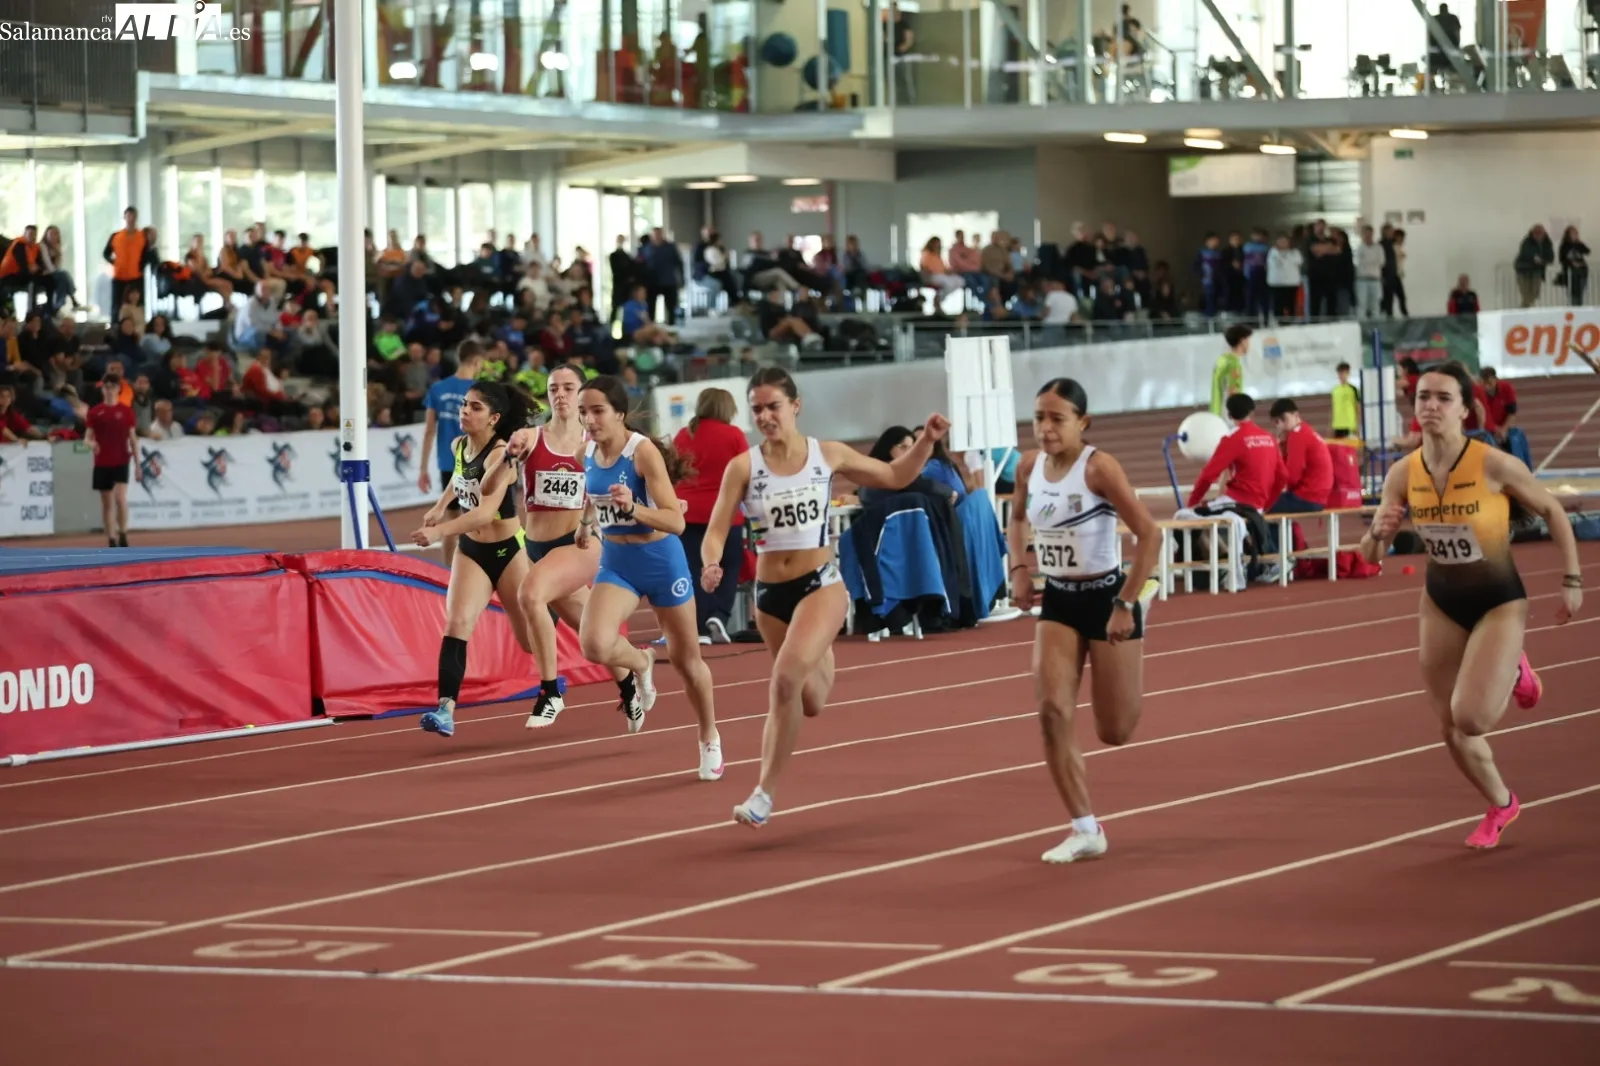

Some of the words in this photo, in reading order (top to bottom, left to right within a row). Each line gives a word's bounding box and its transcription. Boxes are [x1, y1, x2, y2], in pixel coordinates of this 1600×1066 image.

[1505, 311, 1600, 367] enjo
[543, 478, 578, 497] 2443
[770, 499, 819, 528] 2563
[1038, 544, 1078, 568] 2572
[1425, 538, 1472, 559] 2419
[1080, 574, 1117, 592] PRO
[0, 662, 95, 714] ONDO
